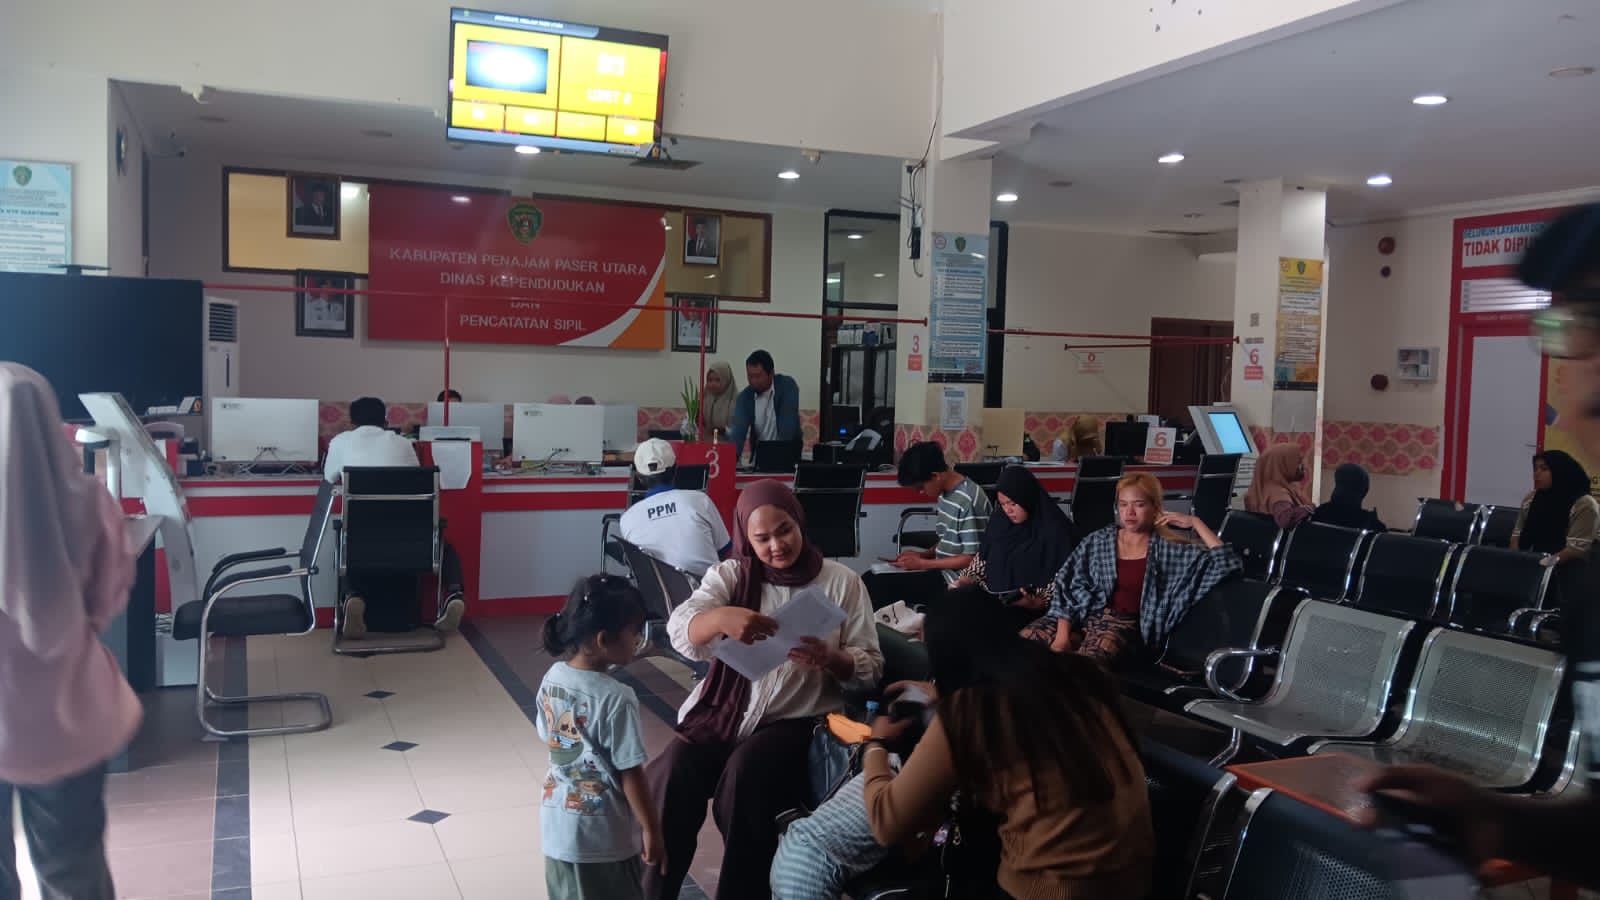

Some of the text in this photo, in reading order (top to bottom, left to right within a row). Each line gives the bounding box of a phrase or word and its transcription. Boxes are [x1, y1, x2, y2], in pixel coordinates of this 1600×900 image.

[1463, 240, 1500, 256] TIDAK
[389, 248, 647, 275] KABUPATEN PENAJAM PASER UTARA
[440, 272, 605, 293] DINAS KEPENDUDUKAN
[460, 314, 586, 331] PENCATATAN SIPIL
[912, 335, 920, 353] 3
[1250, 348, 1259, 364] 6
[1154, 431, 1168, 447] 6
[705, 449, 720, 479] 3
[648, 502, 677, 519] PPM
